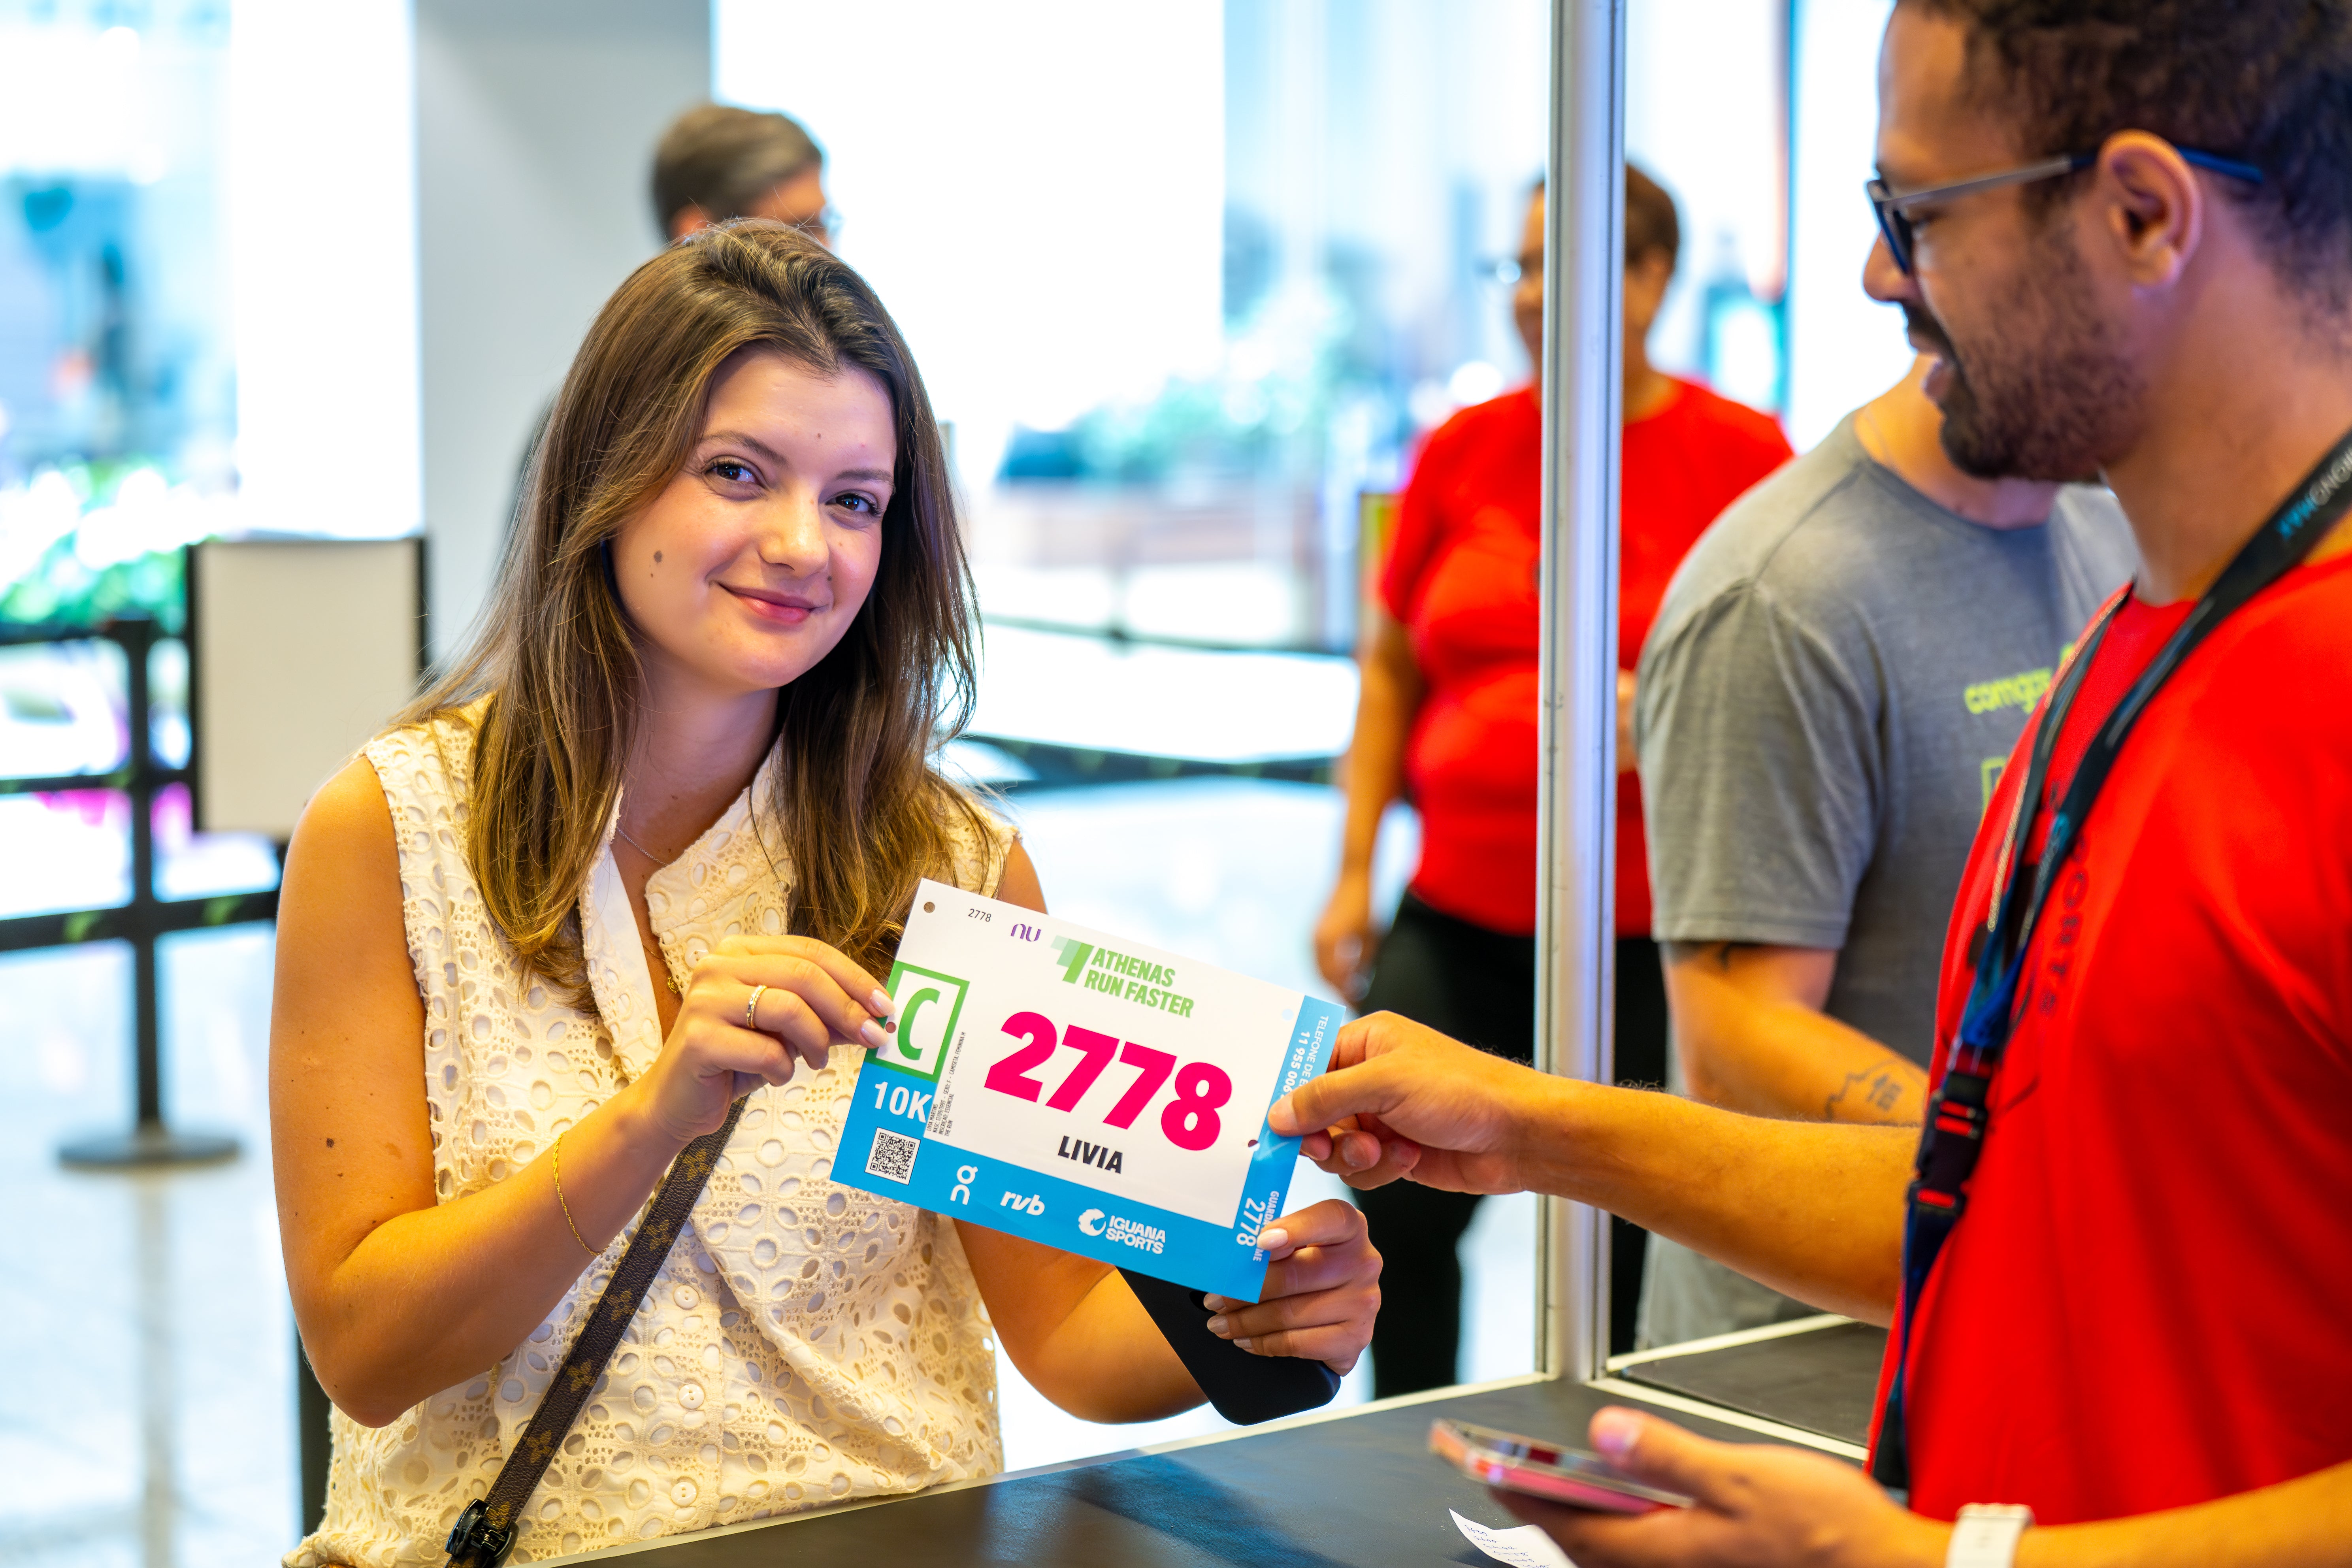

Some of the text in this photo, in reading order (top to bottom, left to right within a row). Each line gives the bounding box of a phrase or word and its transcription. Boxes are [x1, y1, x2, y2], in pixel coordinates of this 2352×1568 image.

[968, 908, 991, 922] 2778
[1091, 947, 1176, 988] ATHENAS
[1084, 969, 1194, 1018] RUN FASTER
[897, 988, 941, 1060] C
[1298, 1031, 1310, 1045] 11
[1306, 1016, 1329, 1063] TELEFONE
[1291, 1048, 1306, 1070] 955
[1302, 1063, 1313, 1078] DE
[984, 1011, 1232, 1151] 2778
[1283, 1070, 1298, 1093] 006
[874, 1081, 933, 1123] 10K
[1057, 1135, 1123, 1174] LIVIA
[1000, 1191, 1045, 1216] rvb
[1109, 1215, 1166, 1242] IGUANA
[1236, 1197, 1266, 1247] 2778
[1105, 1228, 1164, 1255] SPORTS
